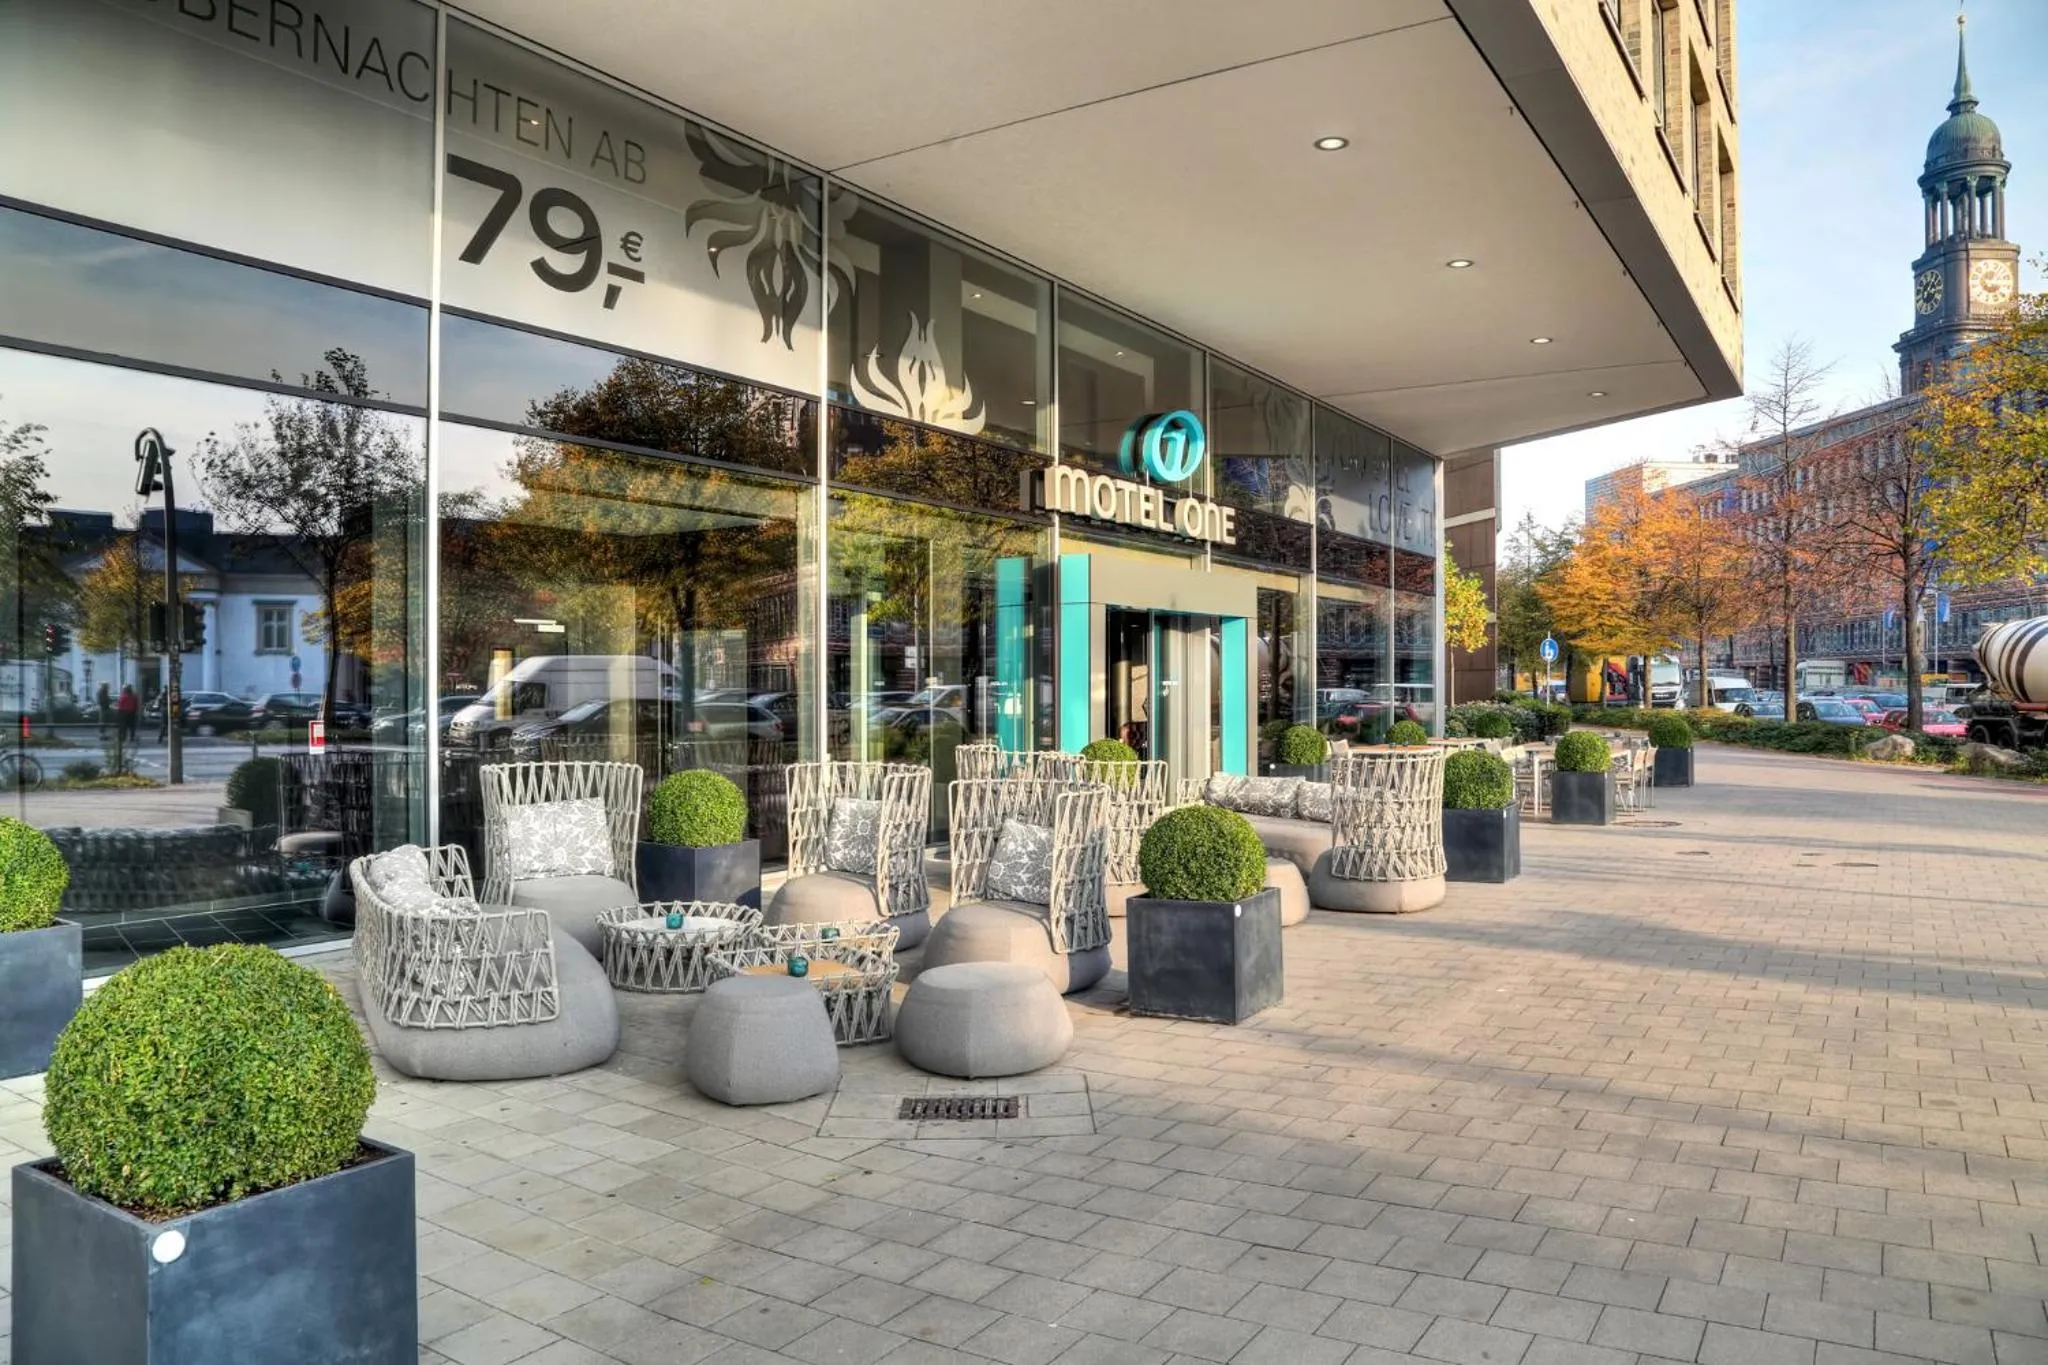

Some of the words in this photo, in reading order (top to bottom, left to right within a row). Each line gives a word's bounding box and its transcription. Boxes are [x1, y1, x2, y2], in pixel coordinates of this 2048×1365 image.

[590, 130, 646, 184] AB
[1046, 464, 1174, 531] MOTEL
[1176, 498, 1237, 545] ONE
